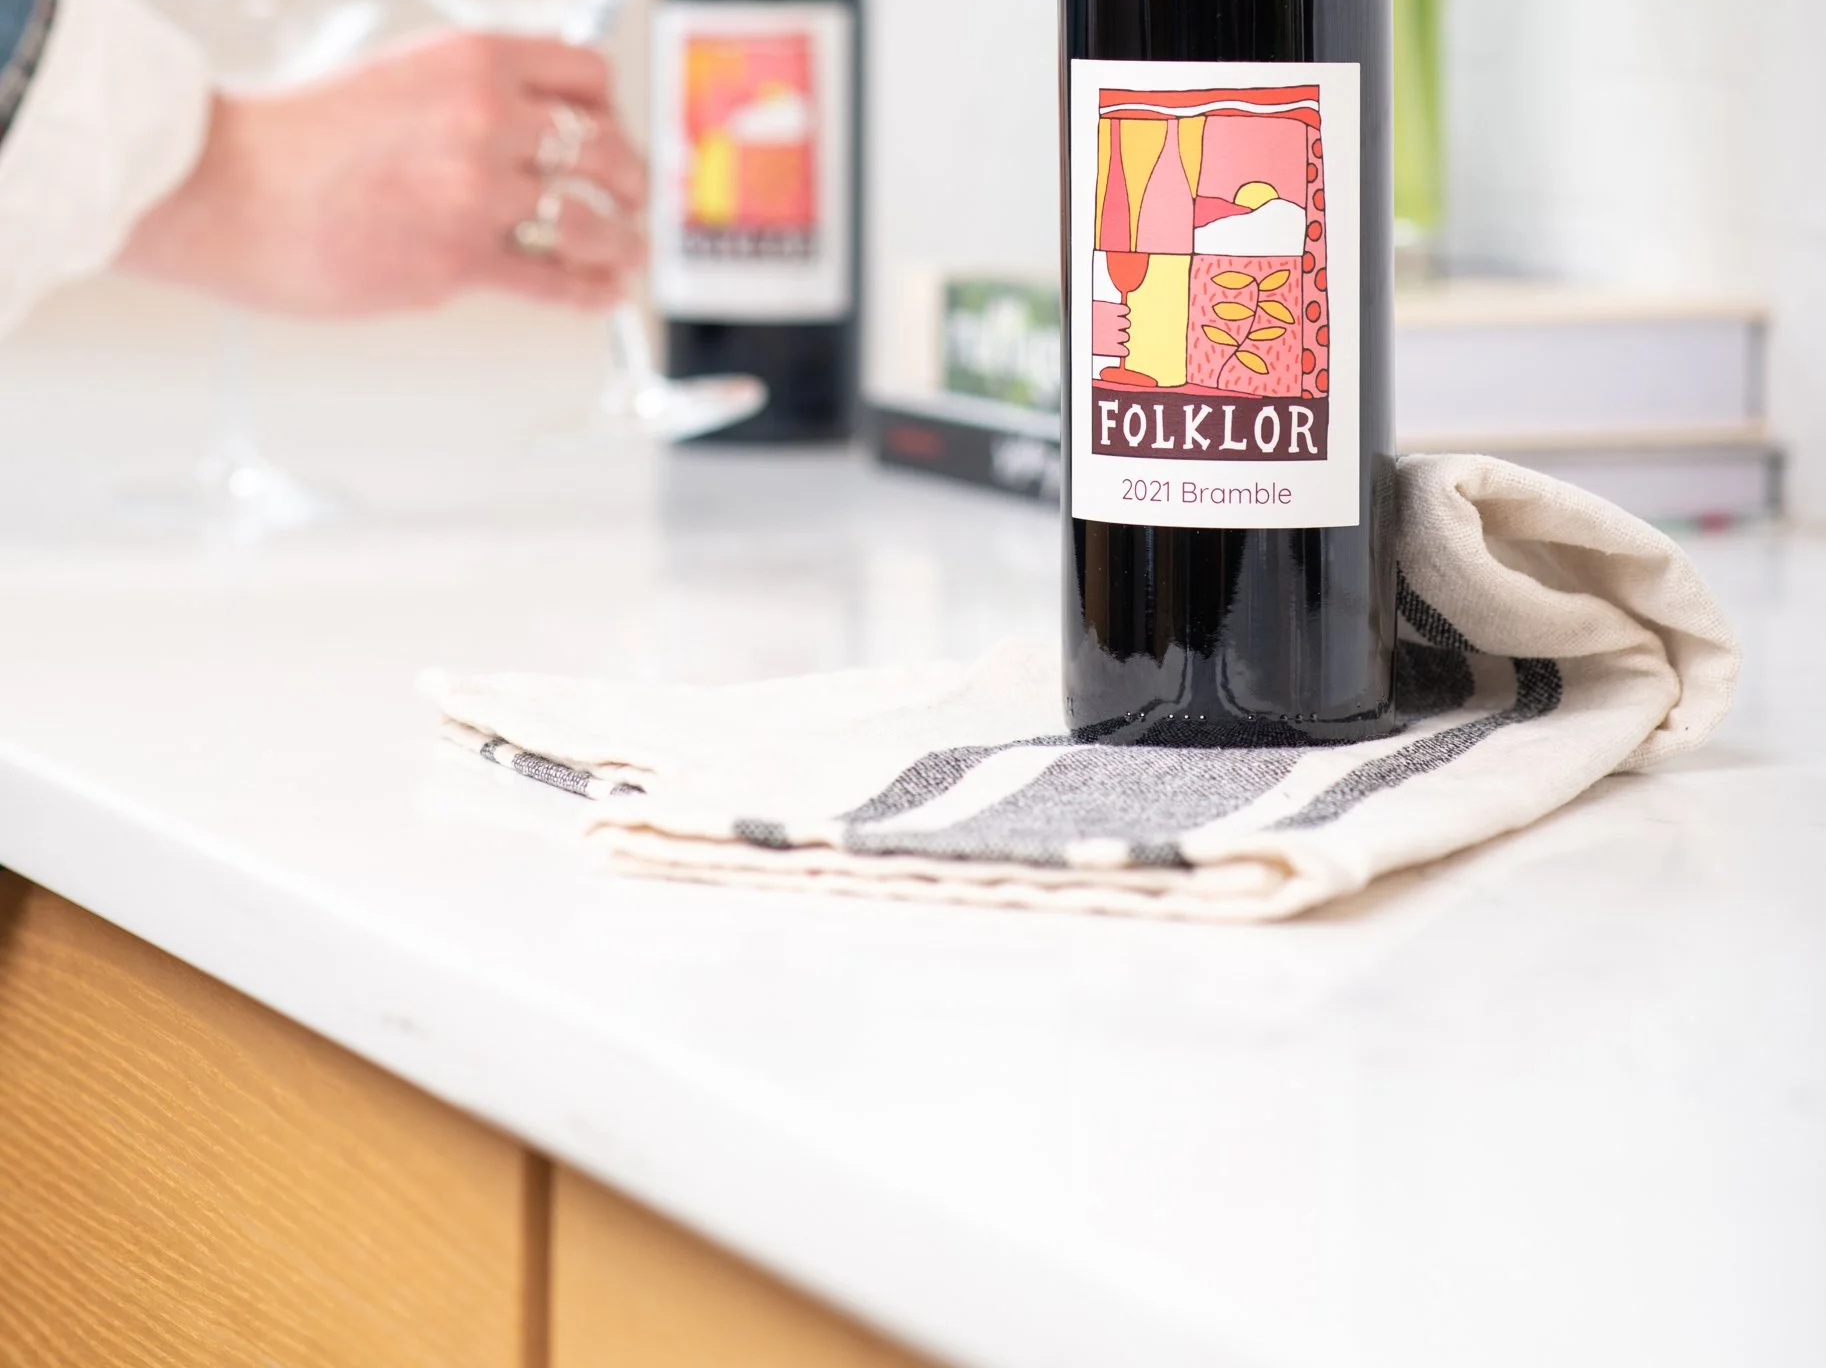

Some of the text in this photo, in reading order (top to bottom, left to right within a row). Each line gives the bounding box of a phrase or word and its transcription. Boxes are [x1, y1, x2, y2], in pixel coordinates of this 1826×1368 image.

[1098, 399, 1318, 454] FOLKLOR
[1122, 478, 1292, 505] 2021 Bramble
